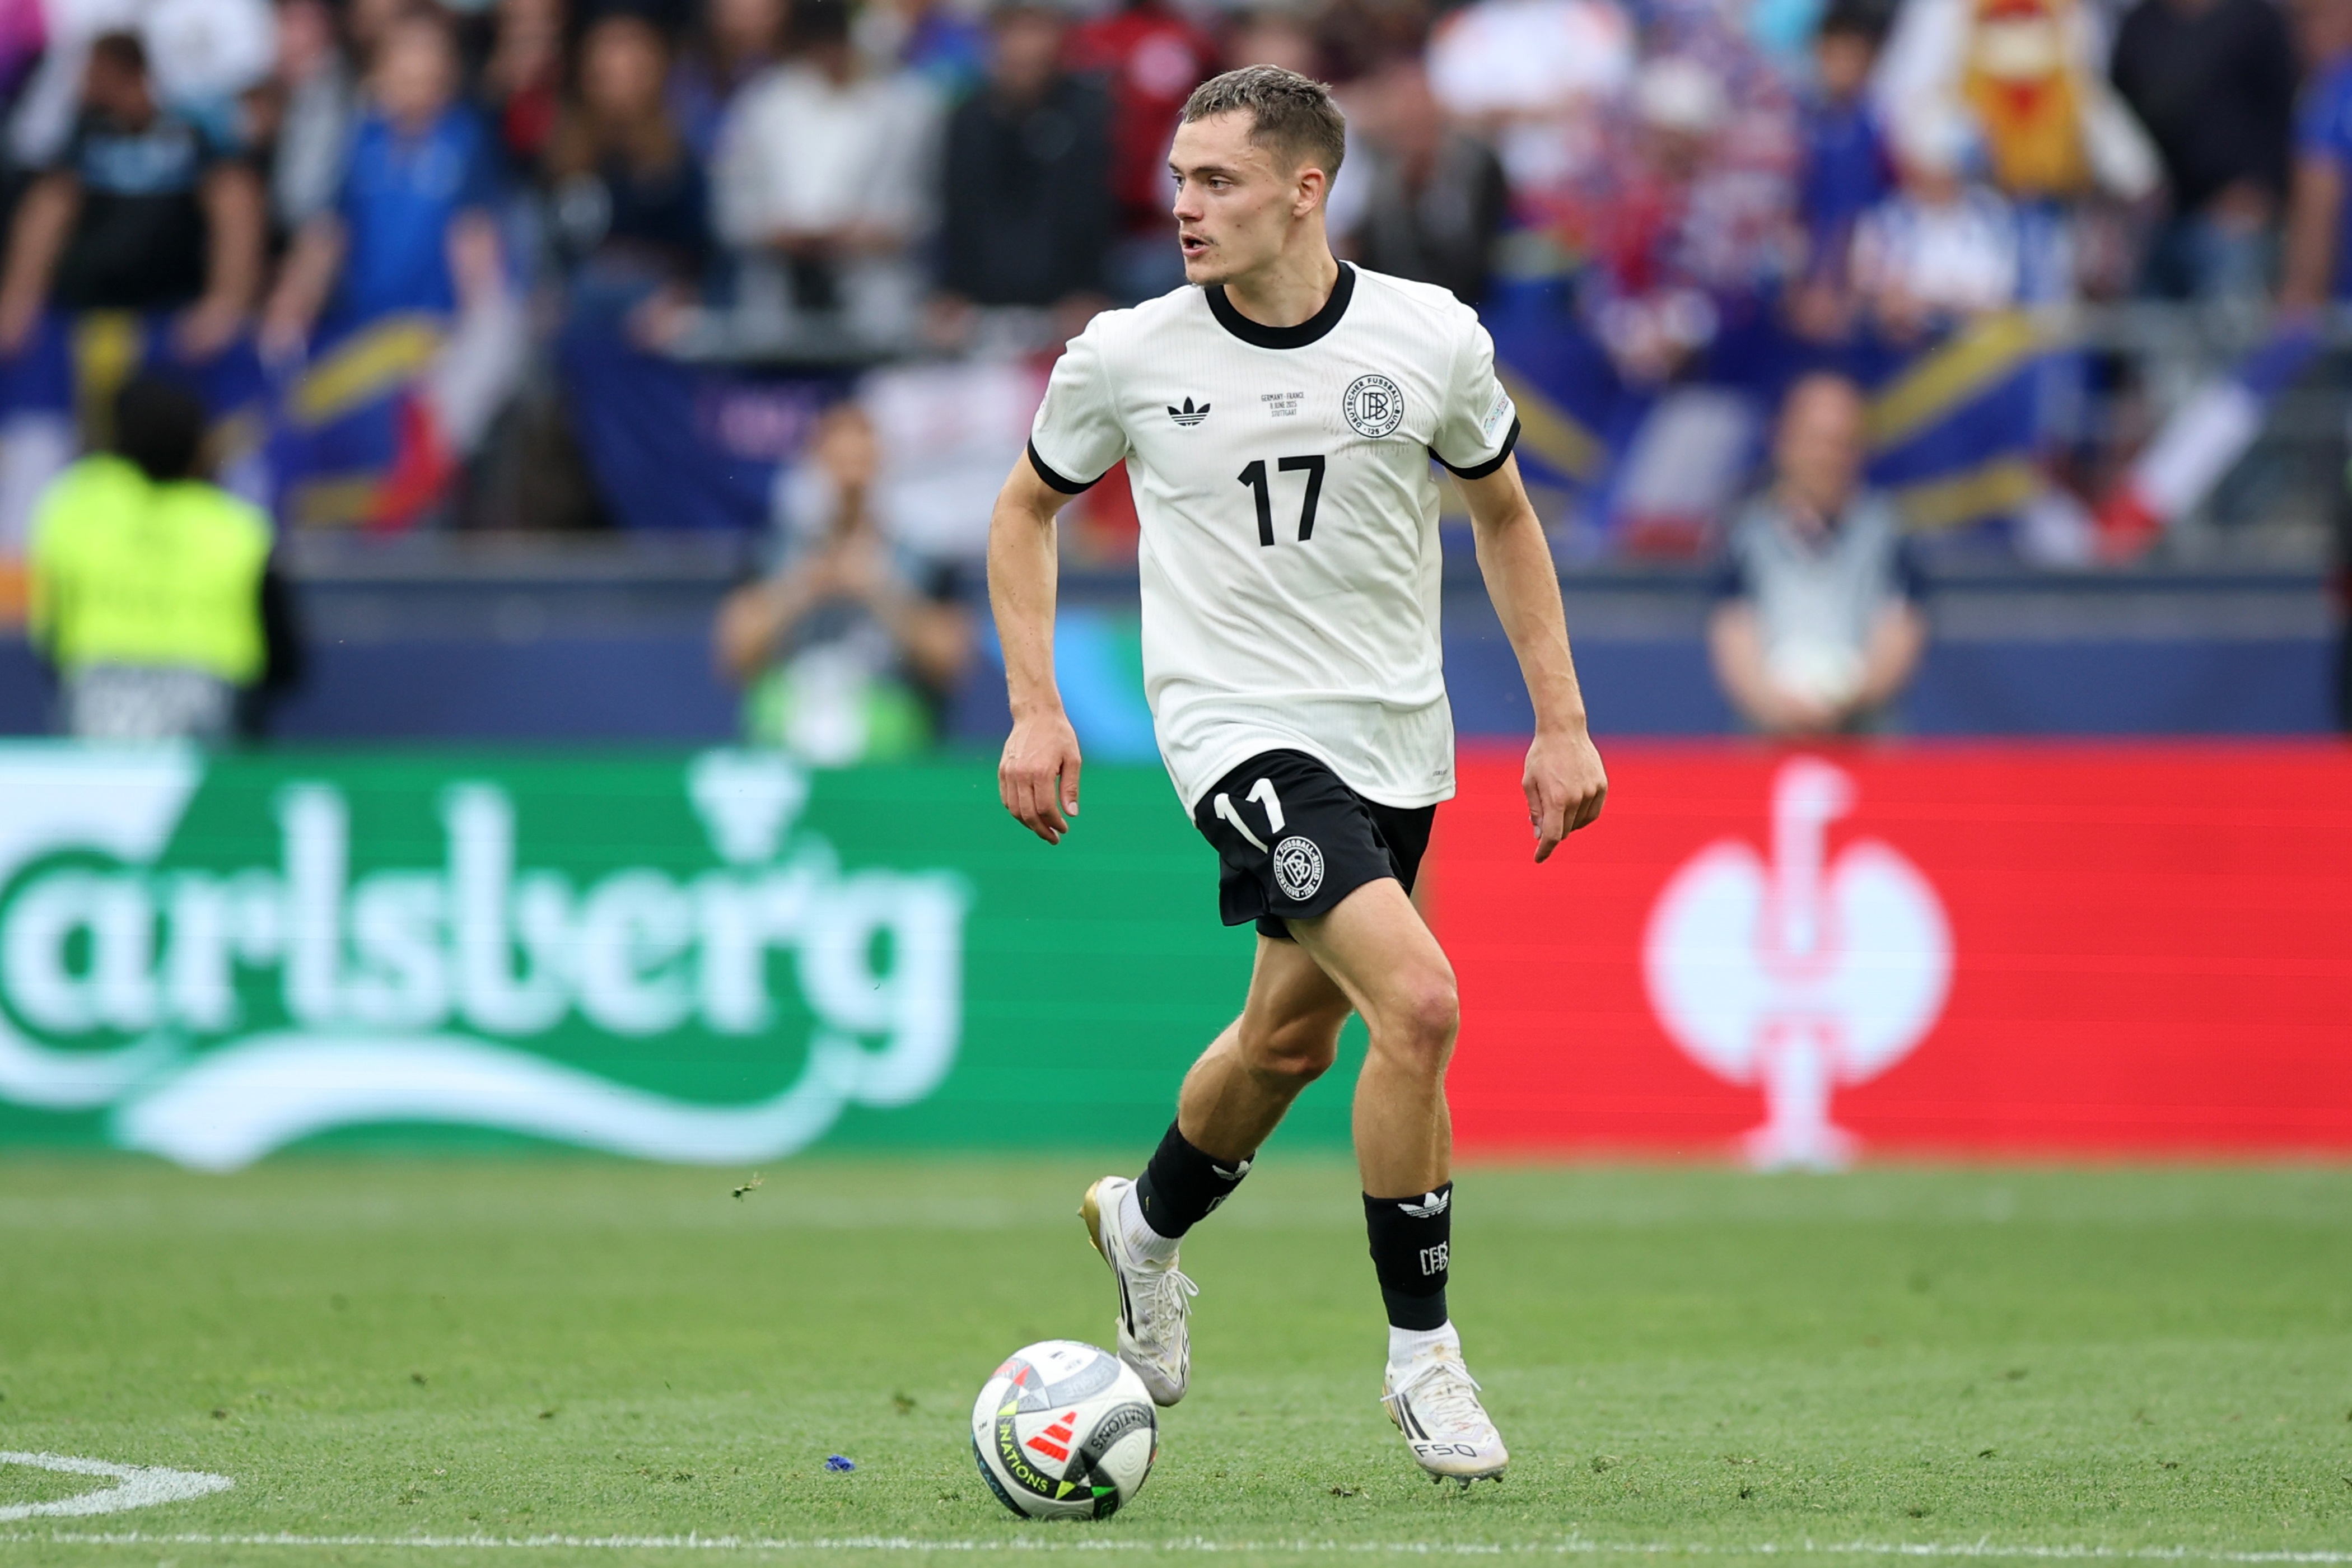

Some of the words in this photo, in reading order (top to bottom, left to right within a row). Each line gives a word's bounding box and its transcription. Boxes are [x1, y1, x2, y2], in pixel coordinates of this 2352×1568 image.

[1261, 393, 1283, 402] GERMANY
[1347, 381, 1364, 428] DEUTSCHER
[1272, 409, 1297, 417] STUTTGART
[1237, 455, 1325, 547] 17
[1000, 1429, 1048, 1492] NATIONS
[1414, 1444, 1477, 1458] F50
